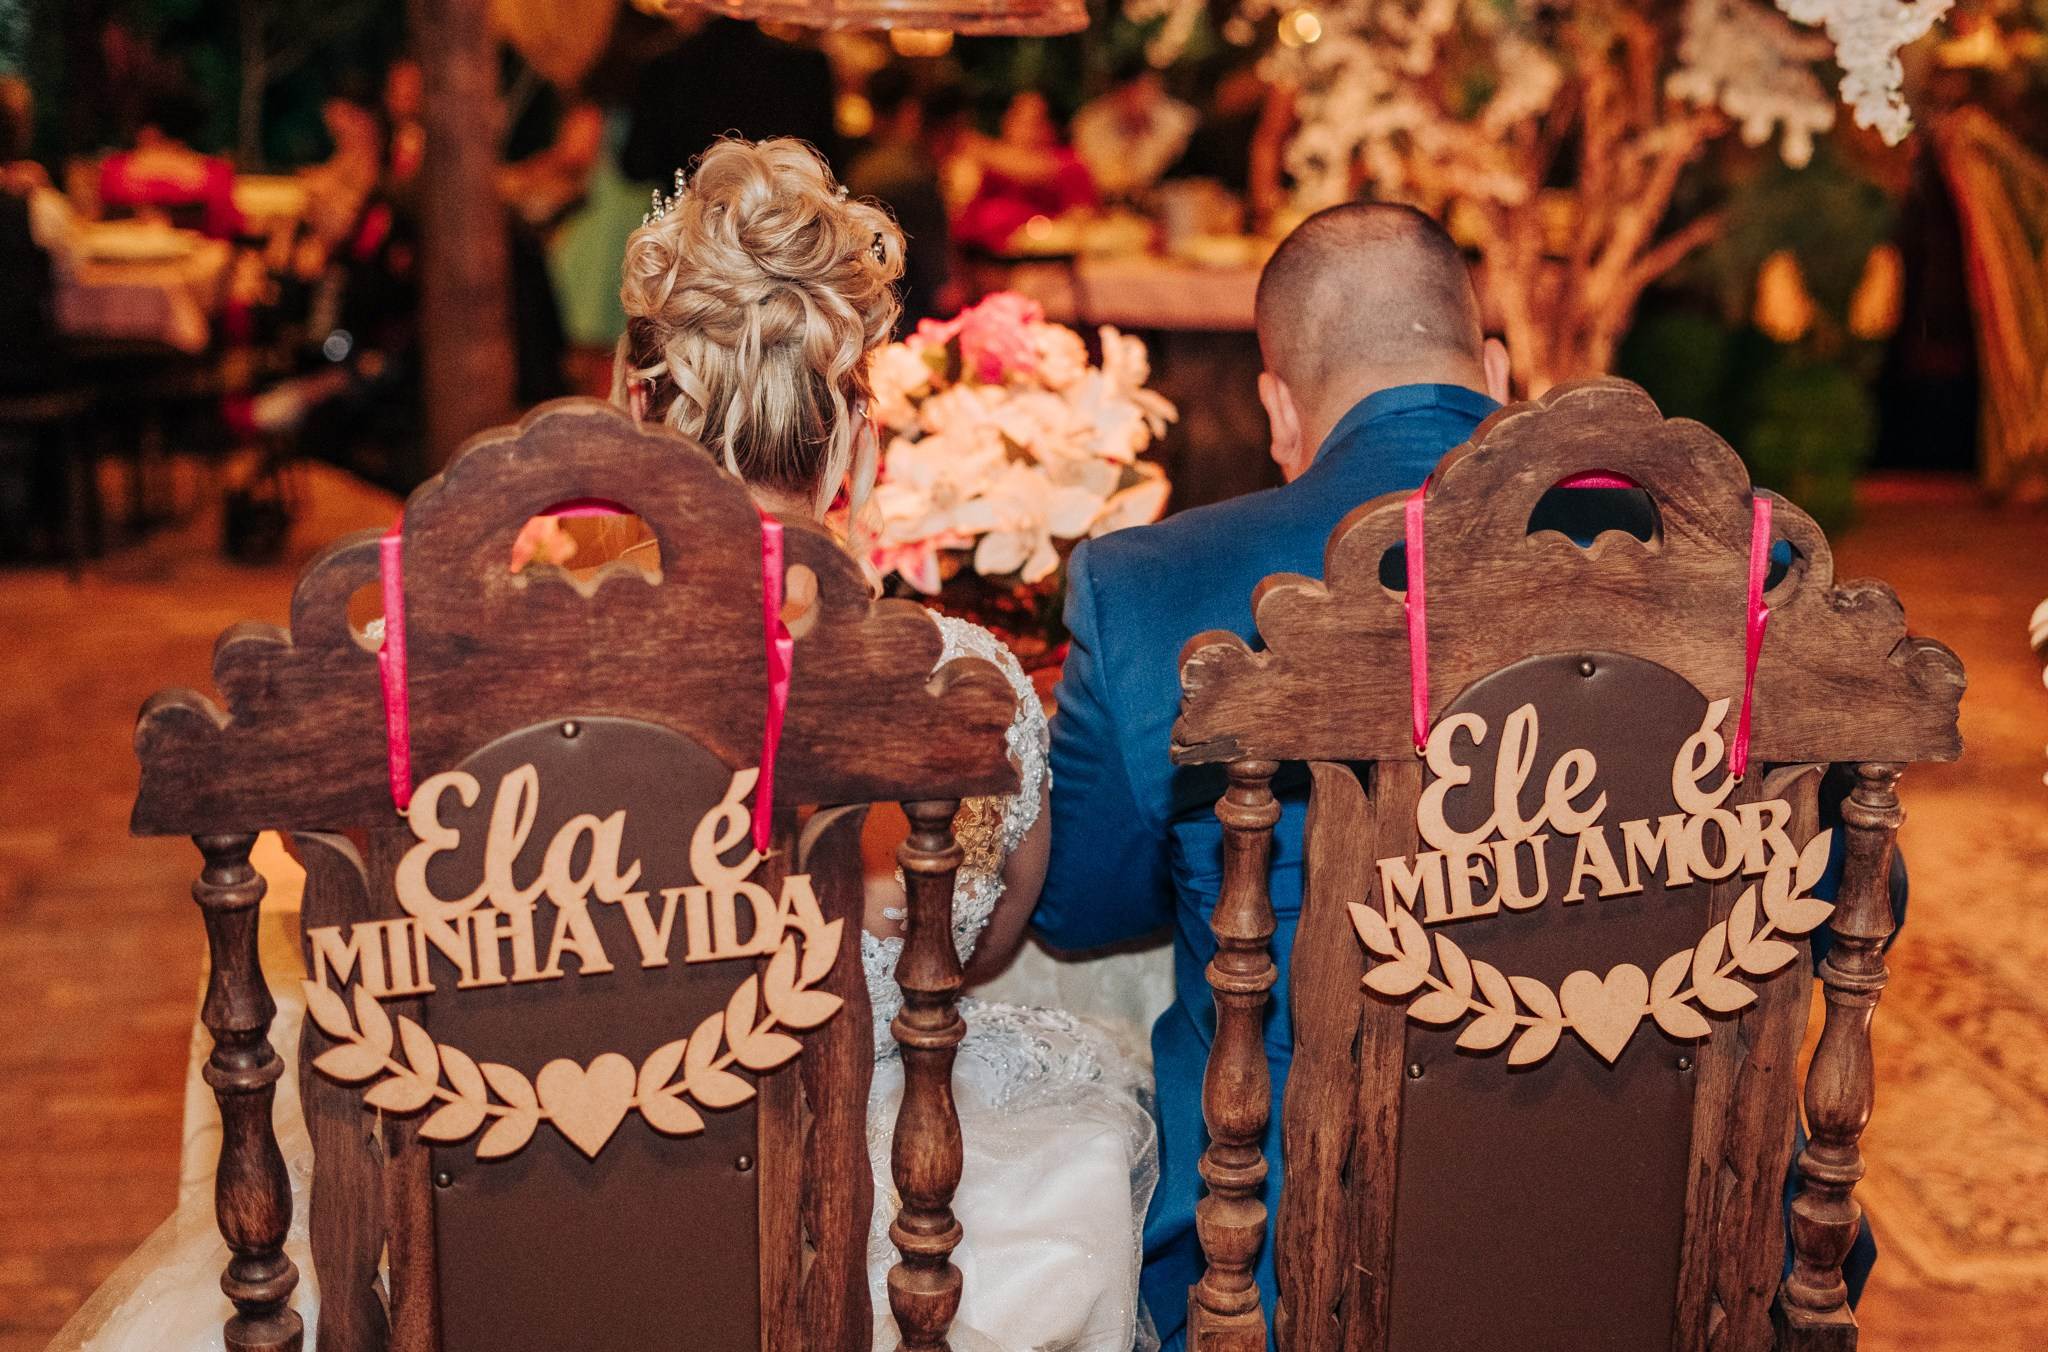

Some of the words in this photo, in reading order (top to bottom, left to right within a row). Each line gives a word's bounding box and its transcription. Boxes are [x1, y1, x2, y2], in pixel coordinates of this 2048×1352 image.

[395, 764, 641, 914] Ela
[690, 767, 763, 886] é
[1417, 703, 1607, 850] Ele
[1672, 698, 1736, 815] é
[1376, 834, 1549, 928] MEU
[1563, 799, 1799, 903] AMOR
[307, 898, 614, 999] MINHA
[622, 874, 828, 967] VIDA
